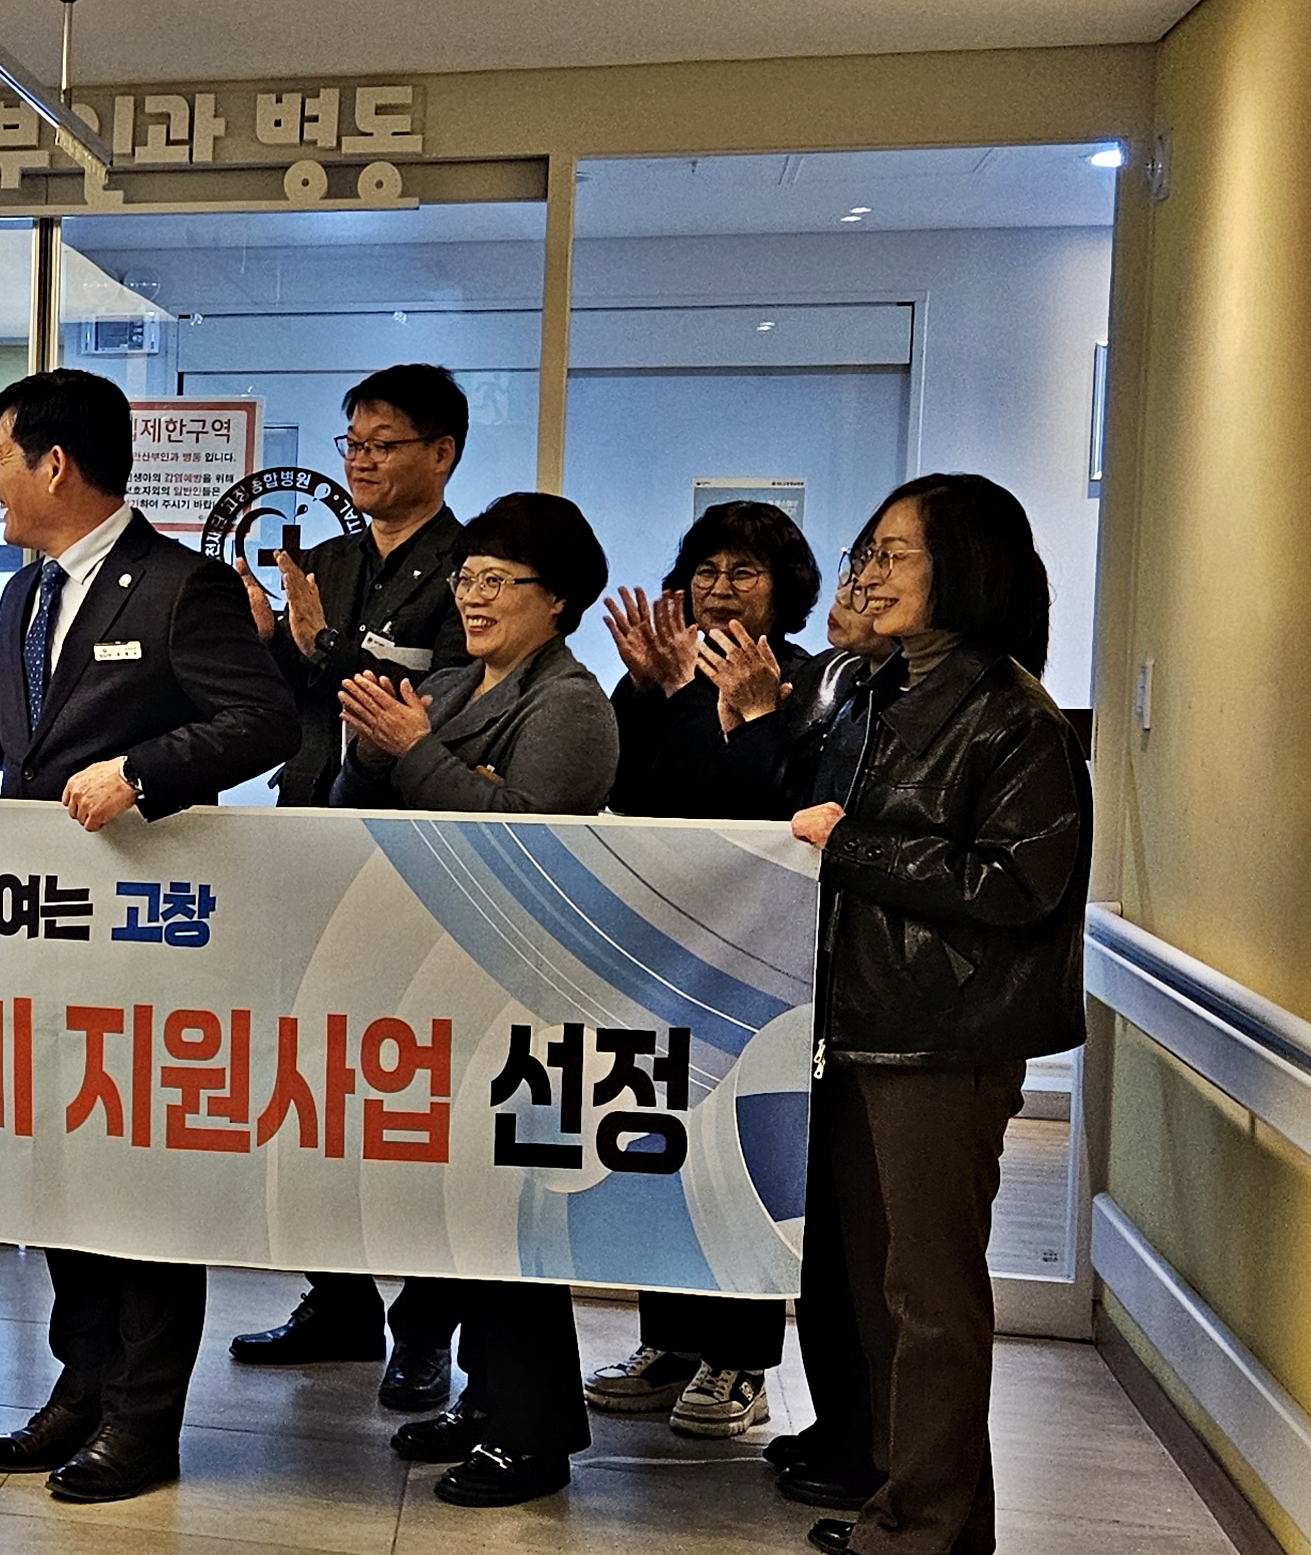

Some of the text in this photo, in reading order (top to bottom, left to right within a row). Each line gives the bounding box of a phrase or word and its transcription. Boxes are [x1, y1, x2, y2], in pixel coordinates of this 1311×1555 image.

[256, 86, 424, 206] 병동
[205, 452, 237, 463] 입니다.
[112, 882, 216, 948] 고창
[66, 1003, 453, 1163] 지원사업
[490, 1022, 692, 1176] 선정
